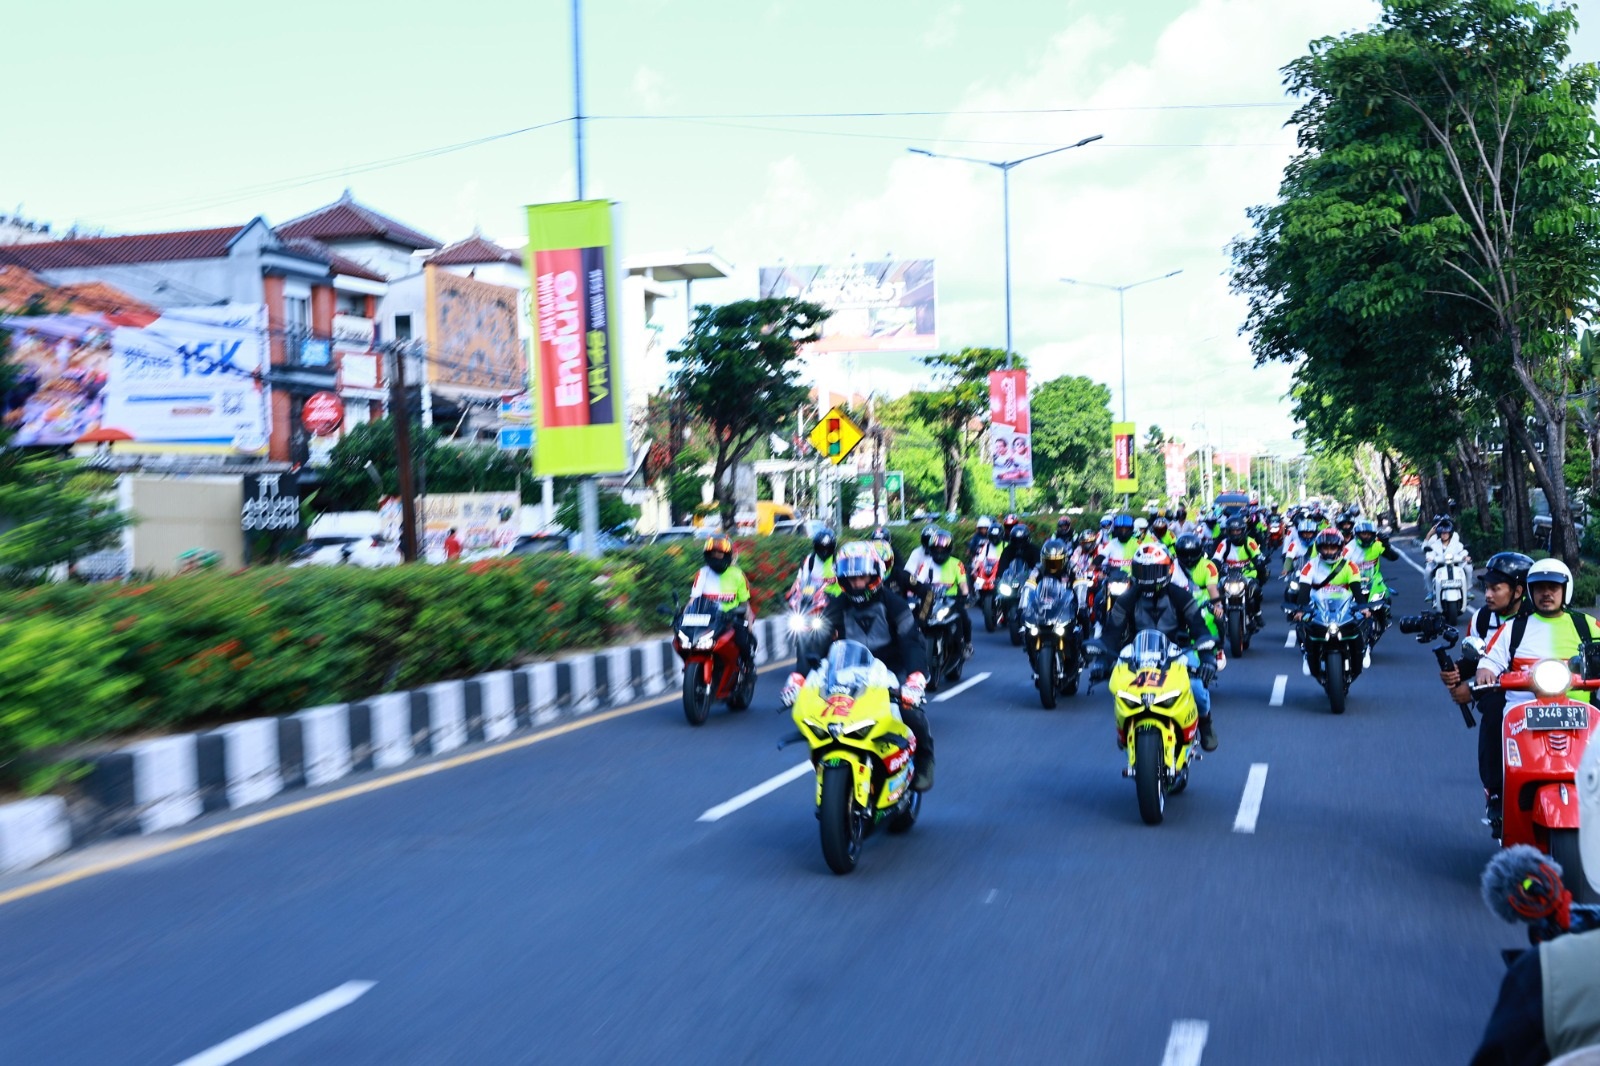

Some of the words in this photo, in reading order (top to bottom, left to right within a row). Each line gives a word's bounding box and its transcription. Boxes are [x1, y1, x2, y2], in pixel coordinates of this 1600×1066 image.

[538, 272, 556, 341] PERTAMINA
[552, 270, 583, 407] Enduro
[241, 496, 299, 515] ABURI
[241, 512, 299, 530] SUSHI
[820, 695, 855, 717] 72
[1527, 708, 1533, 717] B
[1539, 708, 1562, 718] 3446
[1567, 708, 1585, 718] SPY
